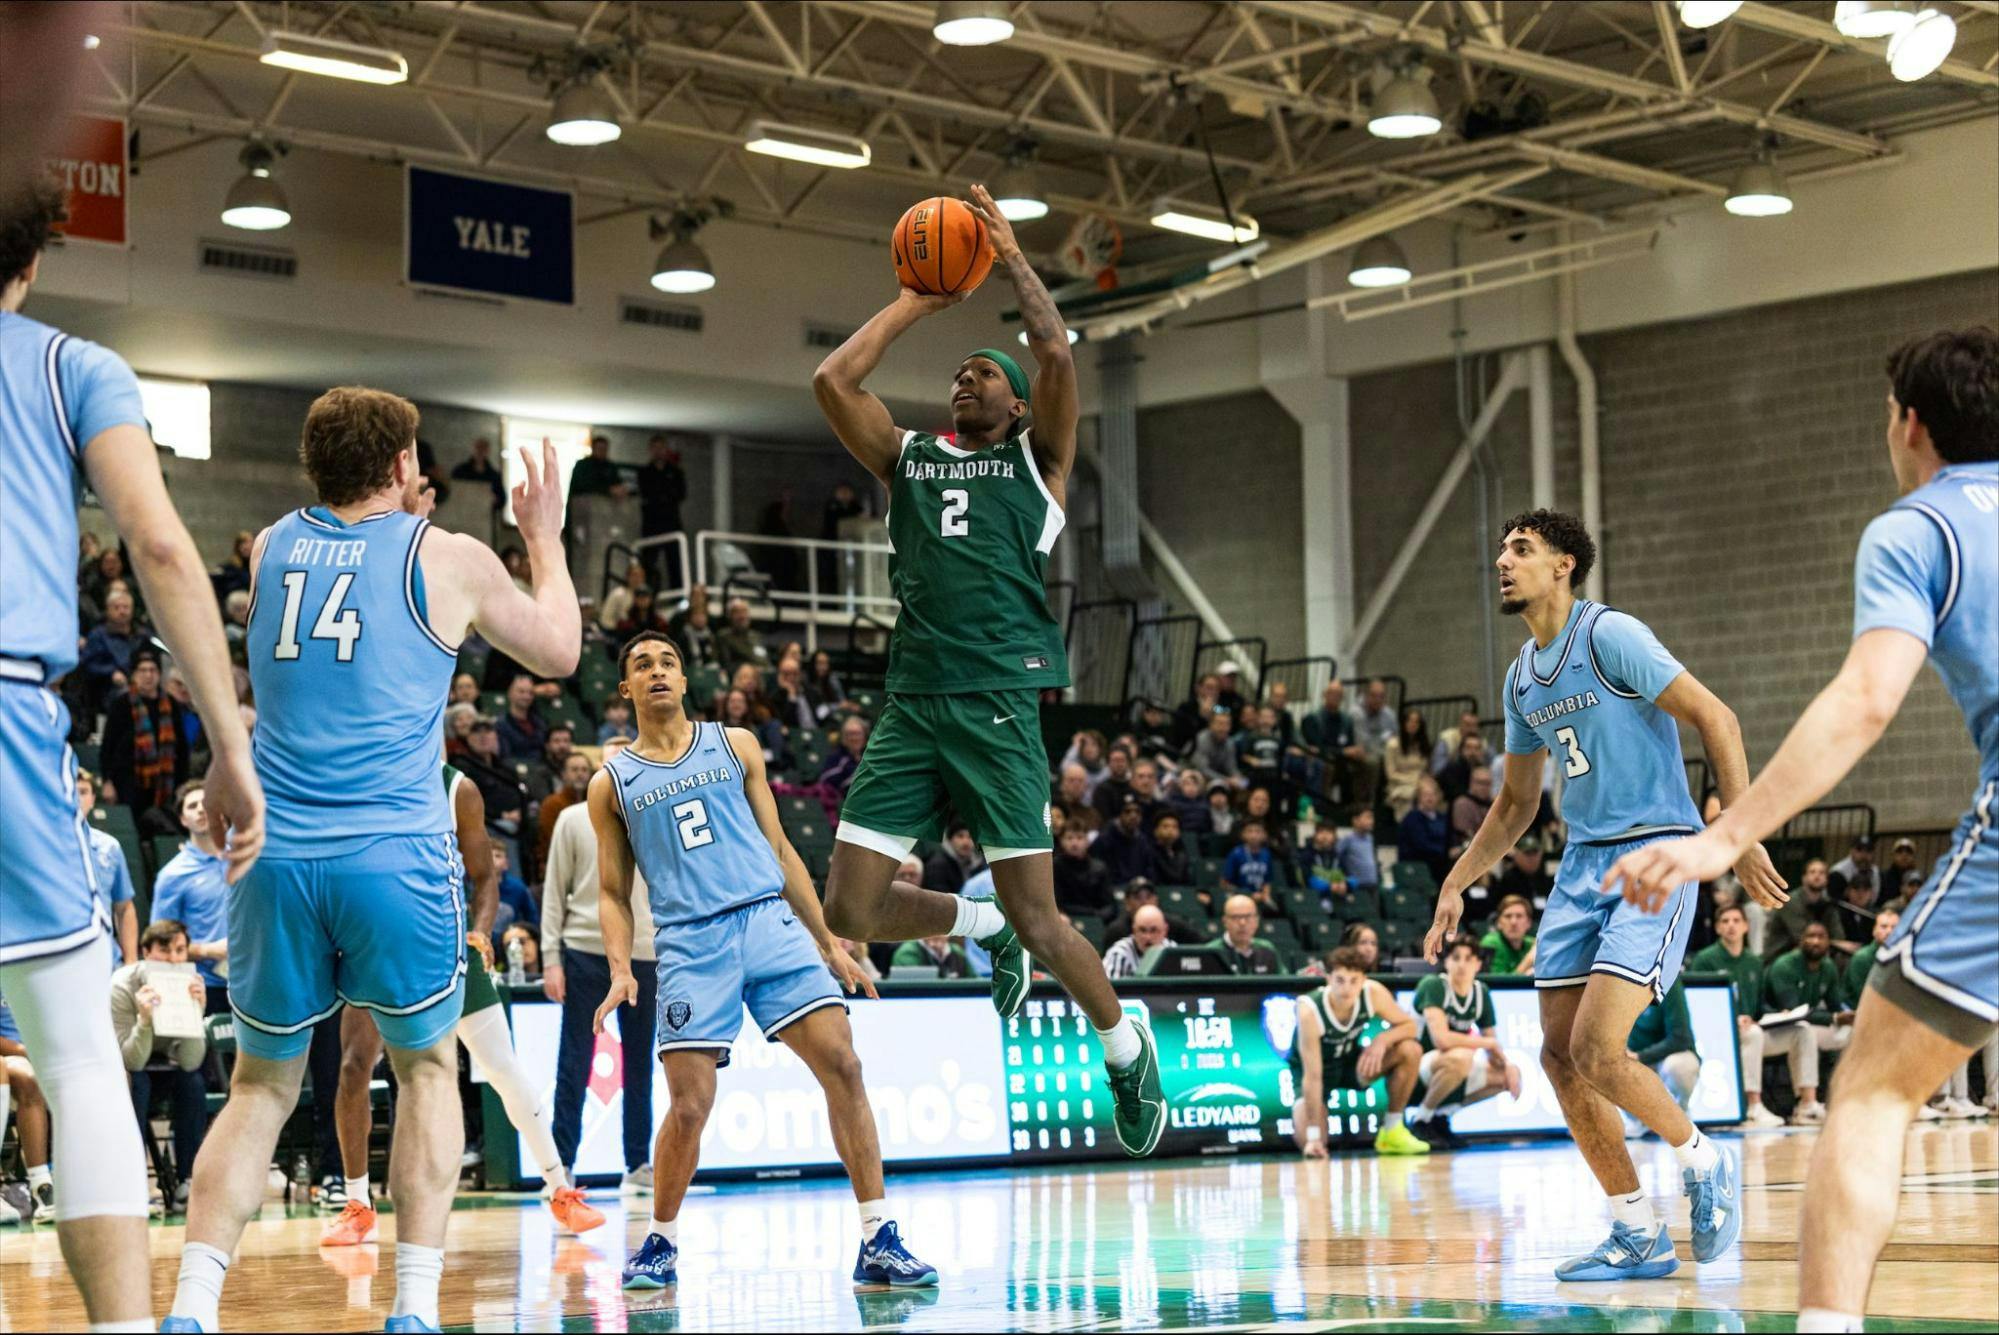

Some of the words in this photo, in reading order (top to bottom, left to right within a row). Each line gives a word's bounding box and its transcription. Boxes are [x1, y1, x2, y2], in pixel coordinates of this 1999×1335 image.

[454, 216, 531, 258] YALE
[914, 209, 928, 260] ELITE
[905, 459, 1015, 481] DARTMOUTH
[941, 488, 969, 537] 2
[288, 538, 366, 566] RITTER
[274, 570, 362, 662] 14
[1555, 725, 1591, 779] 3
[633, 767, 732, 812] COLUMBIA
[672, 798, 715, 852] 2
[1170, 1104, 1261, 1128] LEDYARD
